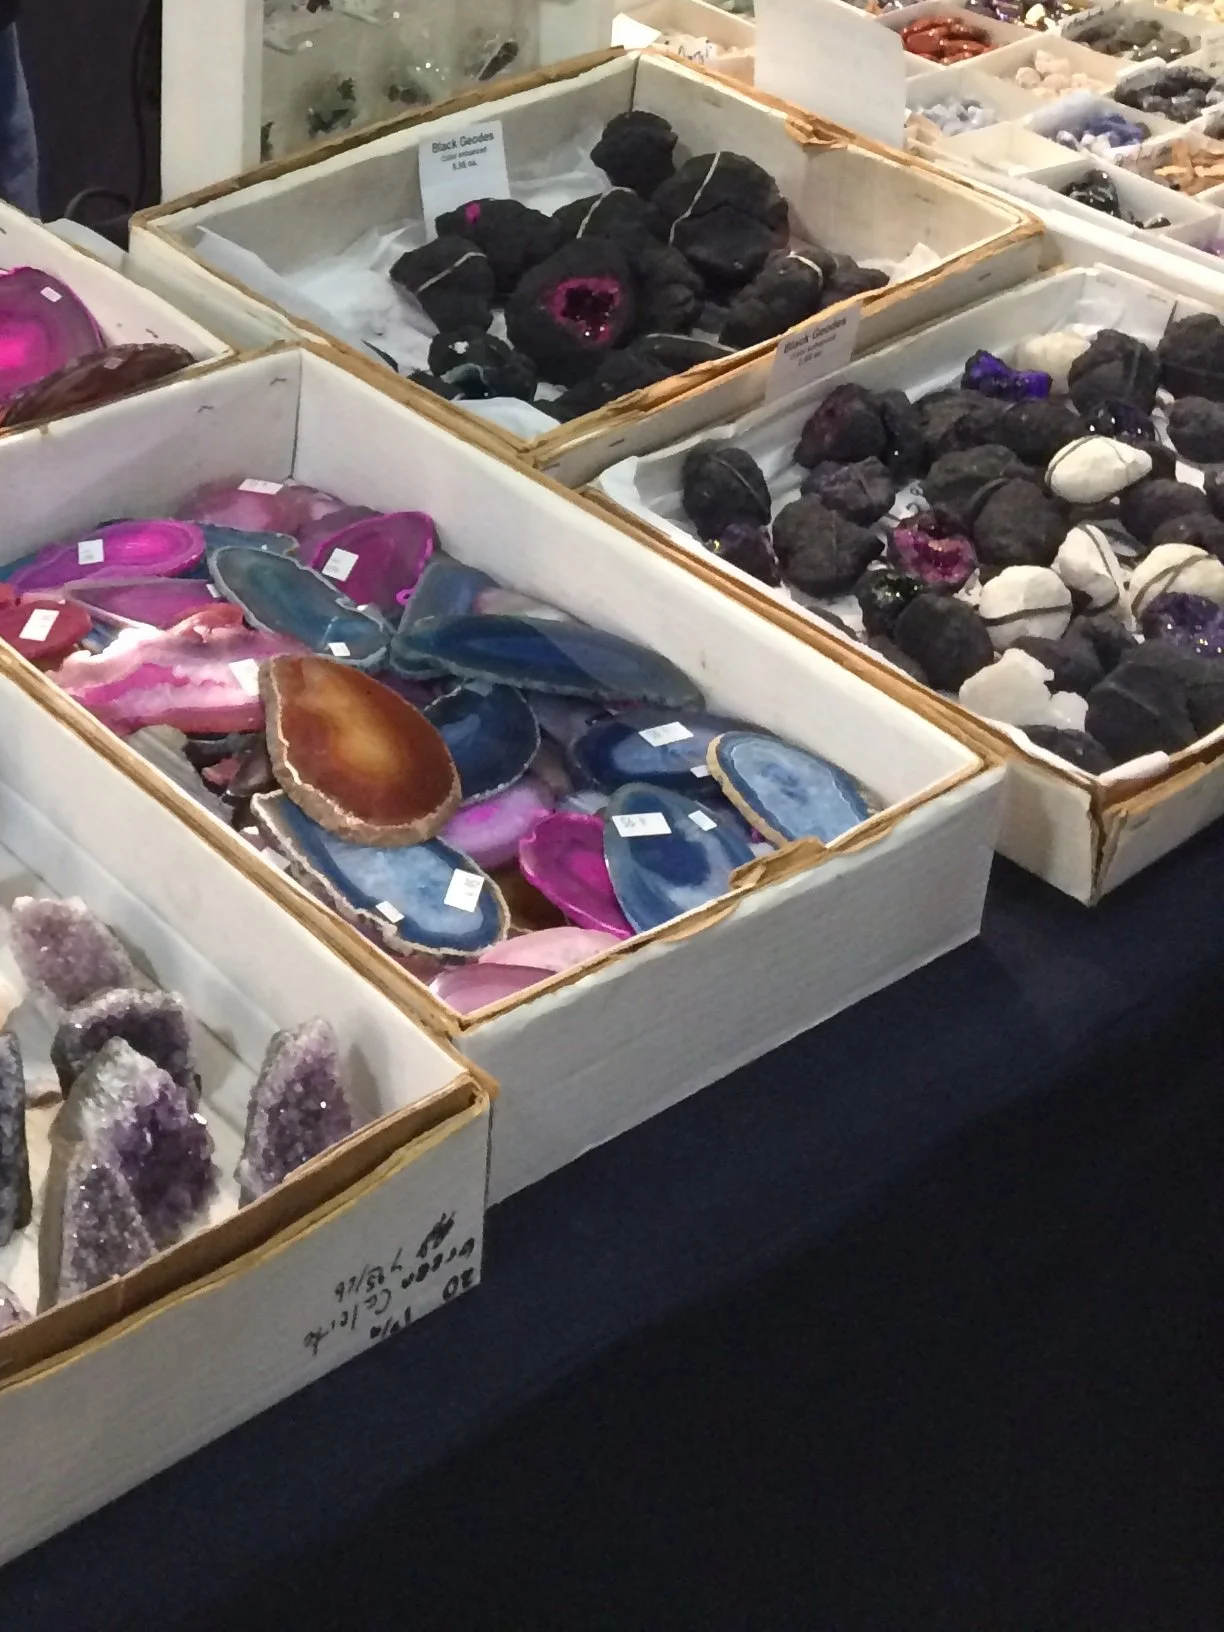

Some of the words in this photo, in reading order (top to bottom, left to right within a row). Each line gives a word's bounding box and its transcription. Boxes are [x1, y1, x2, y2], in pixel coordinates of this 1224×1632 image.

[432, 140, 457, 153] Black
[460, 132, 494, 147] Geodes
[784, 335, 808, 353] Black
[813, 318, 846, 339] Geodes
